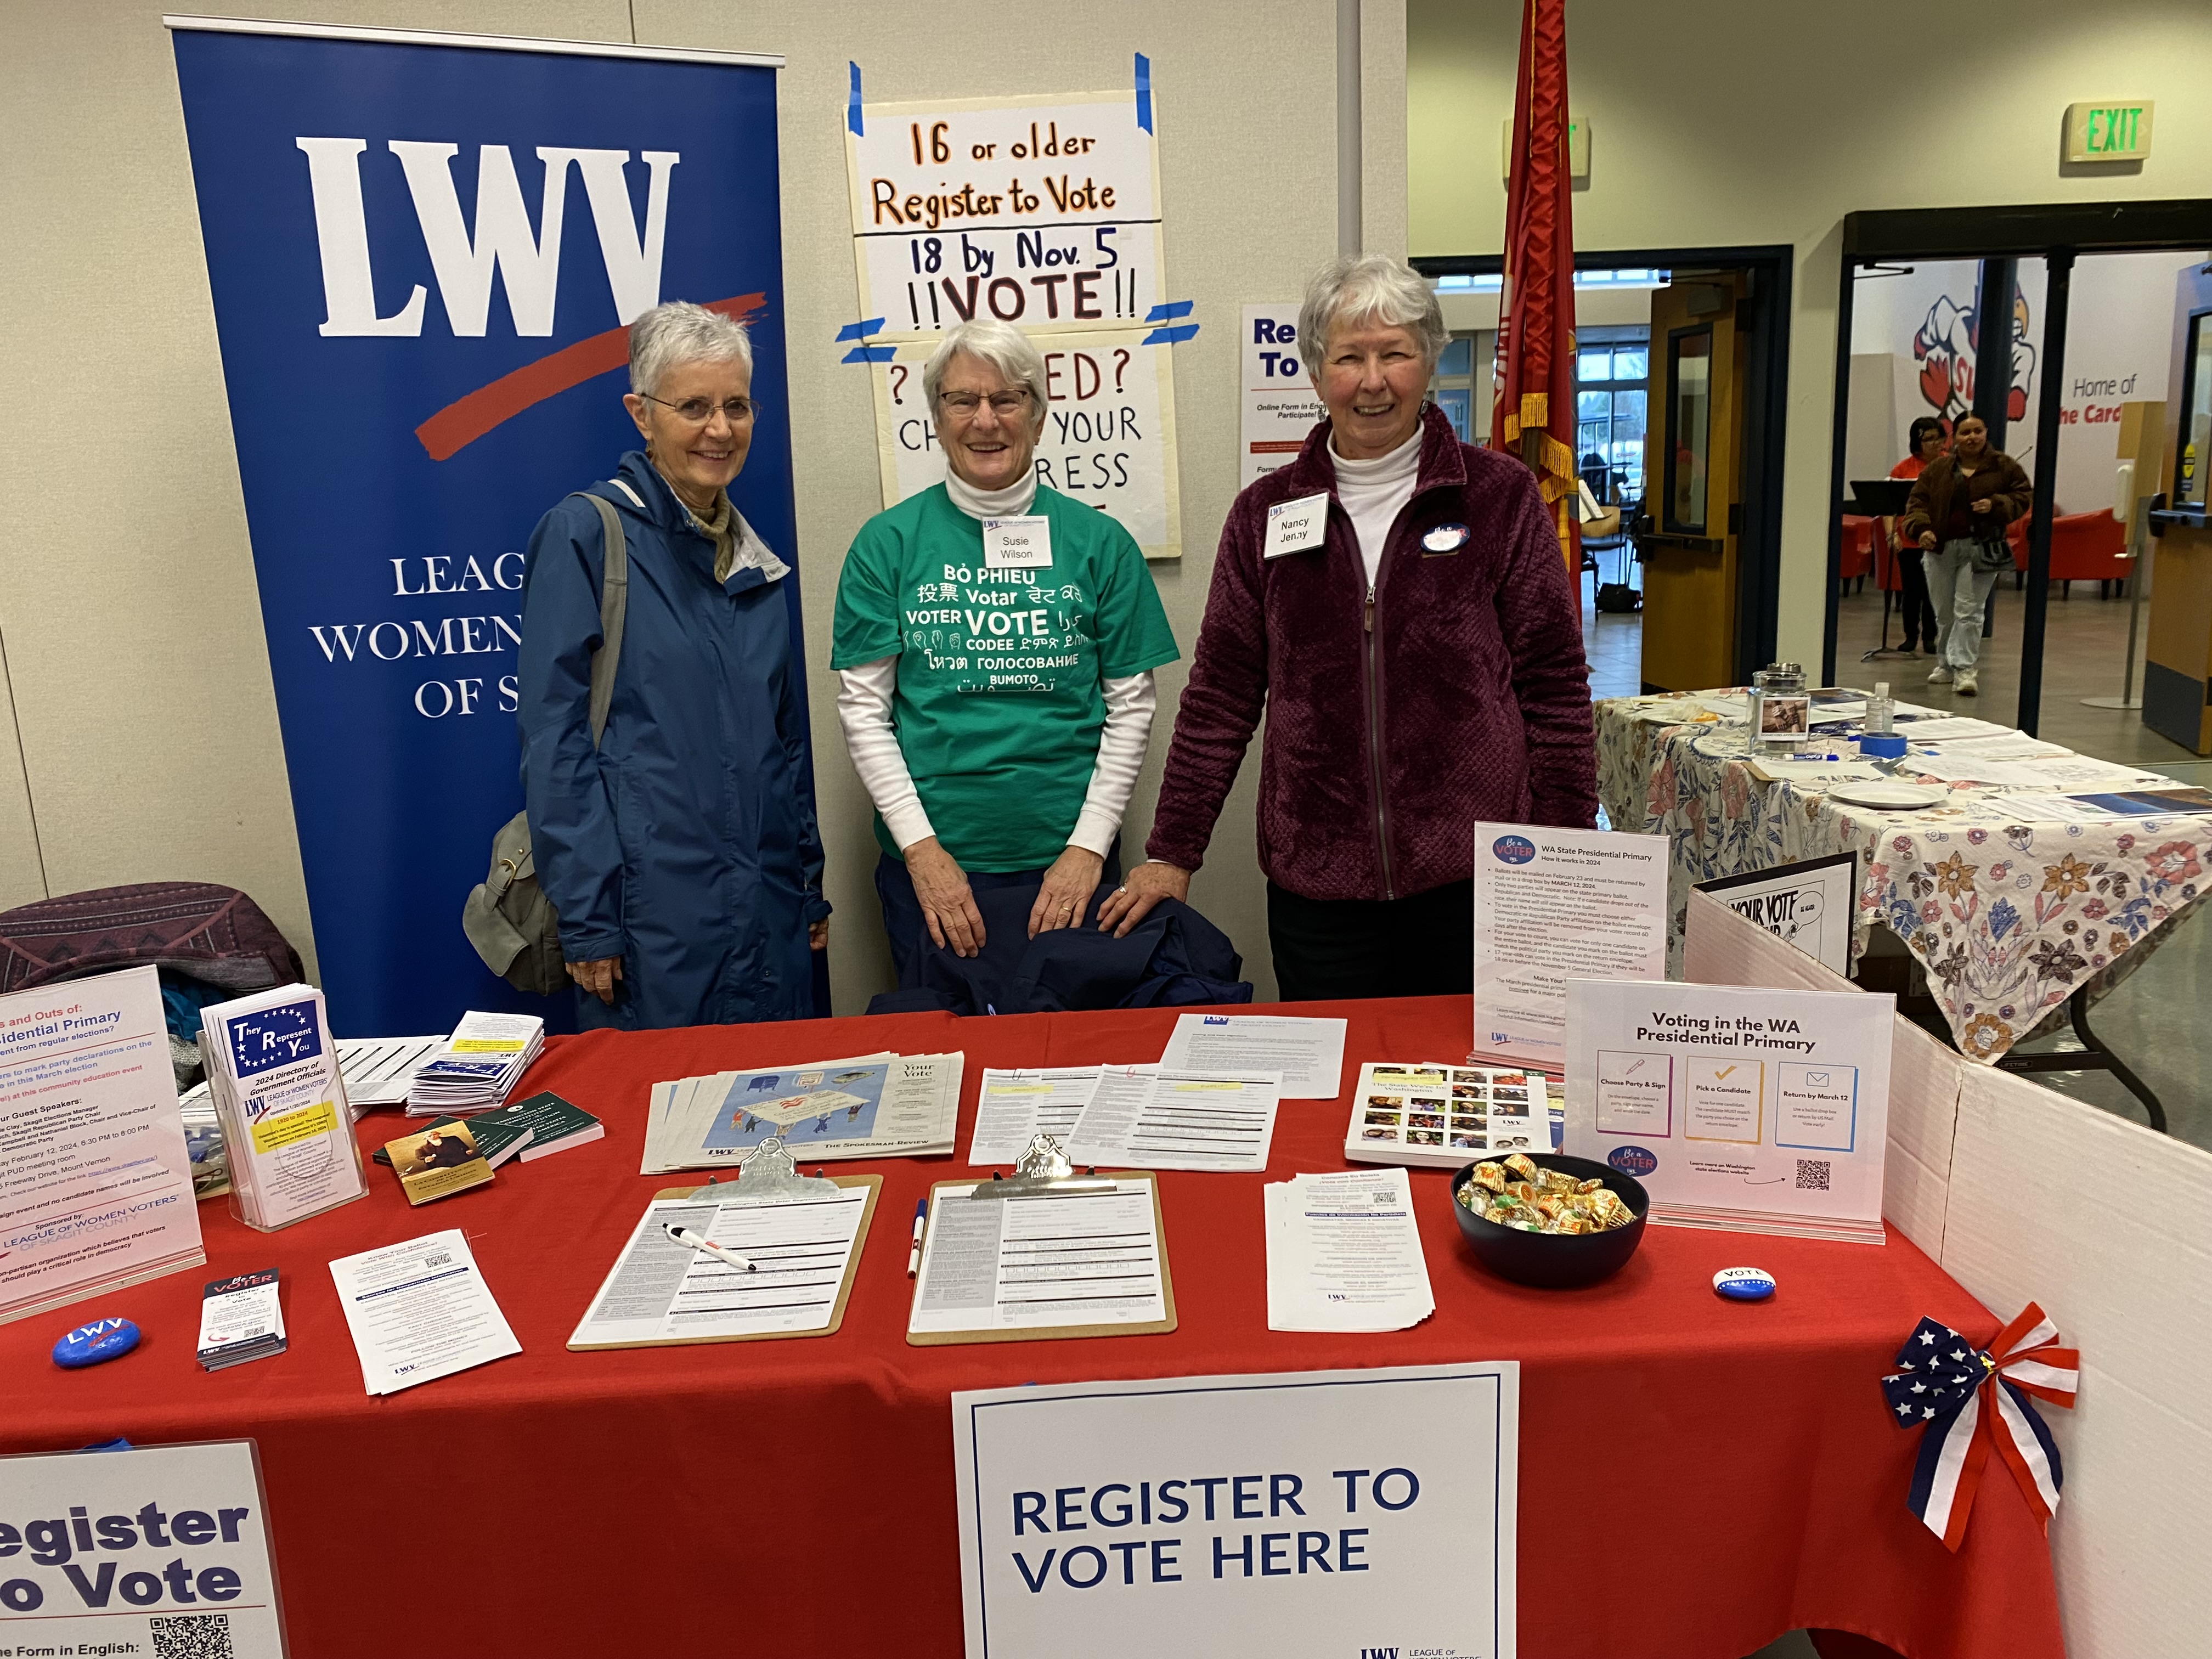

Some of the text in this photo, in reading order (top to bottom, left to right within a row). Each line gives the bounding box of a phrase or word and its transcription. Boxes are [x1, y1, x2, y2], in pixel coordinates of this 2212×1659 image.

[2086, 108, 2143, 154] EXIT
[910, 121, 1096, 166] 16 or older
[871, 174, 1116, 229] Register to Vote
[295, 136, 680, 337] LWV
[911, 227, 1118, 279] 18 by Nov. 5
[1259, 351, 1299, 378] To
[2073, 373, 2138, 398] Home of
[1052, 407, 1142, 445] YOUR
[1277, 411, 1317, 420] Participate!
[1281, 517, 1310, 531] Nancy
[1002, 537, 1029, 546] Susie
[1280, 530, 1308, 544] Jenny
[1000, 550, 1032, 559] Wilson
[917, 582, 959, 603] 投票
[965, 589, 1018, 606] Votar
[906, 610, 962, 625] VOTER
[964, 609, 1050, 636] VOTE
[966, 639, 1014, 651] CODEE
[924, 648, 968, 670] โหวต
[977, 653, 1079, 670] ГОЛОСОВАНИЕ
[990, 675, 1039, 685] BUMOTO
[414, 678, 483, 718] OF
[1496, 844, 1533, 857] VOTER
[1506, 838, 1515, 848] Be
[1557, 847, 1577, 855] State
[1578, 848, 1621, 859] Presidential
[1623, 852, 1652, 862] Primary
[9, 1004, 83, 1027] and Outs of:
[63, 1011, 121, 1031] Primary
[1652, 1012, 1801, 1034] Voting in the WA
[16, 1025, 115, 1053] from regular elections?
[234, 1022, 261, 1042] They
[262, 1027, 312, 1051] Represent
[1637, 1026, 1816, 1054] Presidential Primary
[287, 1038, 310, 1058] You
[25, 1064, 47, 1074] mark
[49, 1059, 70, 1070] party
[72, 1047, 125, 1063] declarations
[250, 1068, 326, 1096] Government Officials
[255, 1060, 319, 1086] 2024 Directory of
[1600, 1079, 1624, 1087] Choose
[290, 1084, 310, 1094] WOMEN
[1717, 1086, 1751, 1094] Candidate
[12, 1098, 82, 1120] Guest Speakers:
[244, 1095, 266, 1118] LWV
[12, 1151, 44, 1164] February
[59, 1142, 80, 1152] 2024,
[98, 1133, 111, 1142] PM
[120, 1128, 137, 1137] 8:00
[137, 1124, 150, 1132] PM
[1624, 1149, 1634, 1158] Be
[1611, 1156, 1654, 1169] VOTER
[1725, 1163, 1756, 1171] Washington
[3, 1228, 56, 1249] LEAGUE
[58, 1224, 72, 1233] OF
[75, 1209, 126, 1228] WOMEN
[35, 1216, 72, 1231] Sponsored
[213, 1274, 273, 1293] VOTER
[232, 1276, 246, 1285] Be
[66, 1318, 123, 1345] LWV
[394, 1364, 415, 1374] LWV
[1012, 1468, 1421, 1536] REGISTER TO
[1011, 1528, 1370, 1594] VOTE HERE
[60, 1558, 242, 1609] Vote
[17, 1642, 140, 1657] Form in English:
[1409, 1649, 1443, 1657] LEAGUE
